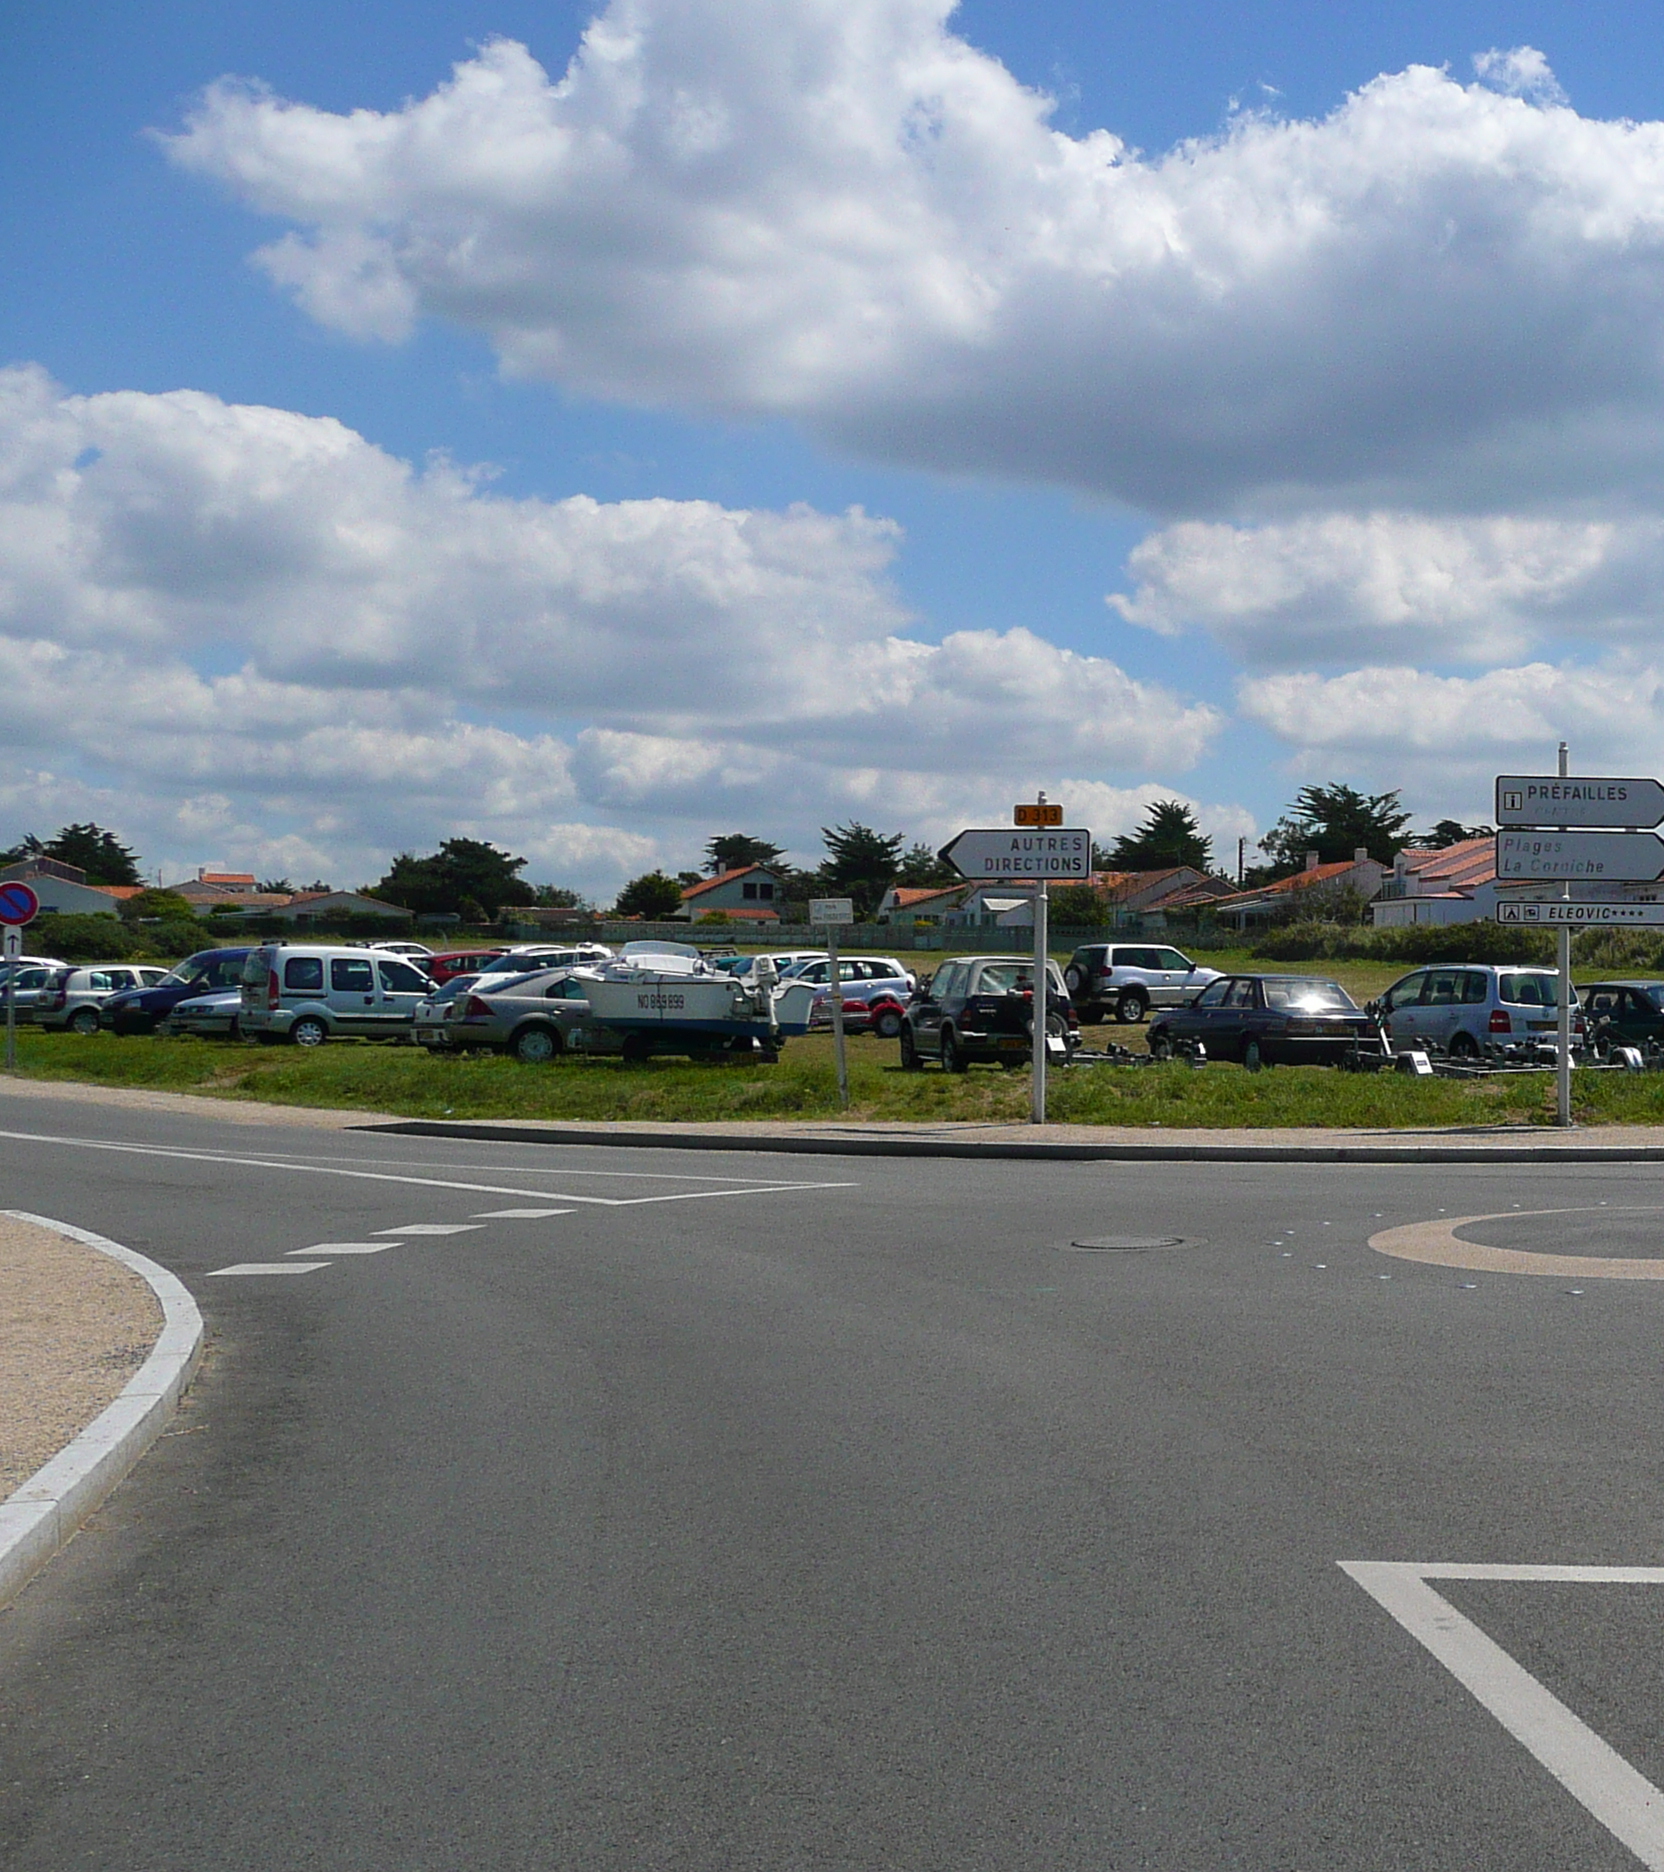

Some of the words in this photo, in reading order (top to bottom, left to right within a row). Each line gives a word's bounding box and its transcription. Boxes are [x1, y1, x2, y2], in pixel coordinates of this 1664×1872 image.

[1528, 782, 1628, 801] PRÉFAILLES
[1018, 808, 1027, 822] D
[1032, 808, 1058, 822] 313
[1010, 837, 1082, 851] AUTRES
[1504, 838, 1562, 855] Plages
[985, 857, 1082, 871] DIRECTIONS
[1504, 859, 1522, 872] La
[1530, 859, 1604, 873] Corniche
